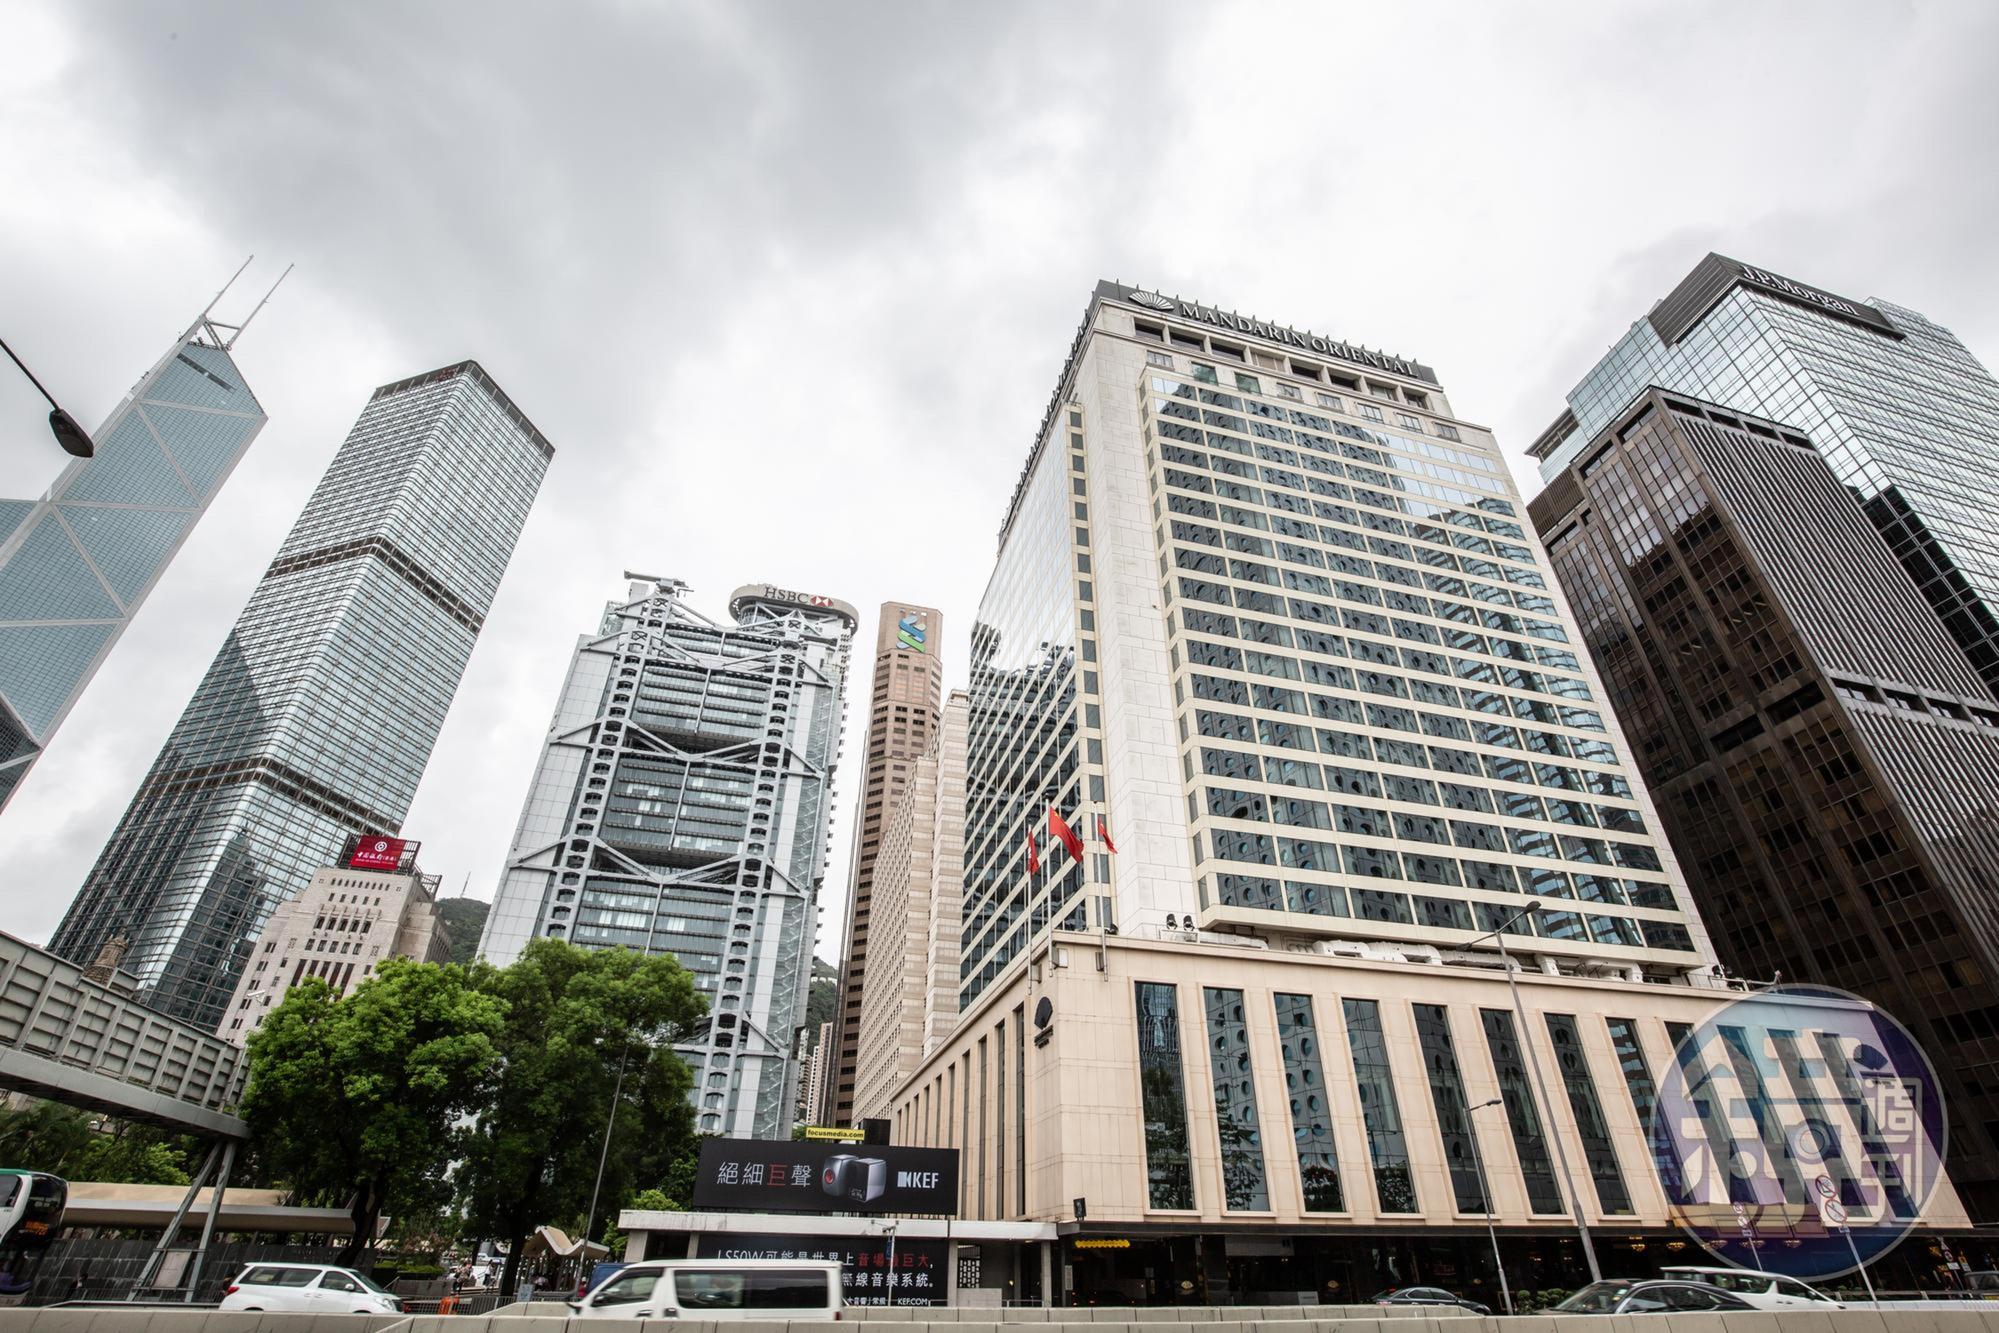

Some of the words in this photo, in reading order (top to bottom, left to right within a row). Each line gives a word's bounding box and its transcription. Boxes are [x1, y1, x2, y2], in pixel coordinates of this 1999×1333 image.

[1179, 303, 1306, 348] MANDARIN
[1310, 337, 1419, 378] ORIENTAL
[763, 586, 809, 604] HSBC
[807, 1128, 864, 1139] focusmedia.com
[717, 1161, 812, 1187] 絕細巨聲
[912, 1172, 939, 1189] KEF
[897, 1297, 928, 1306] KEF.COM
